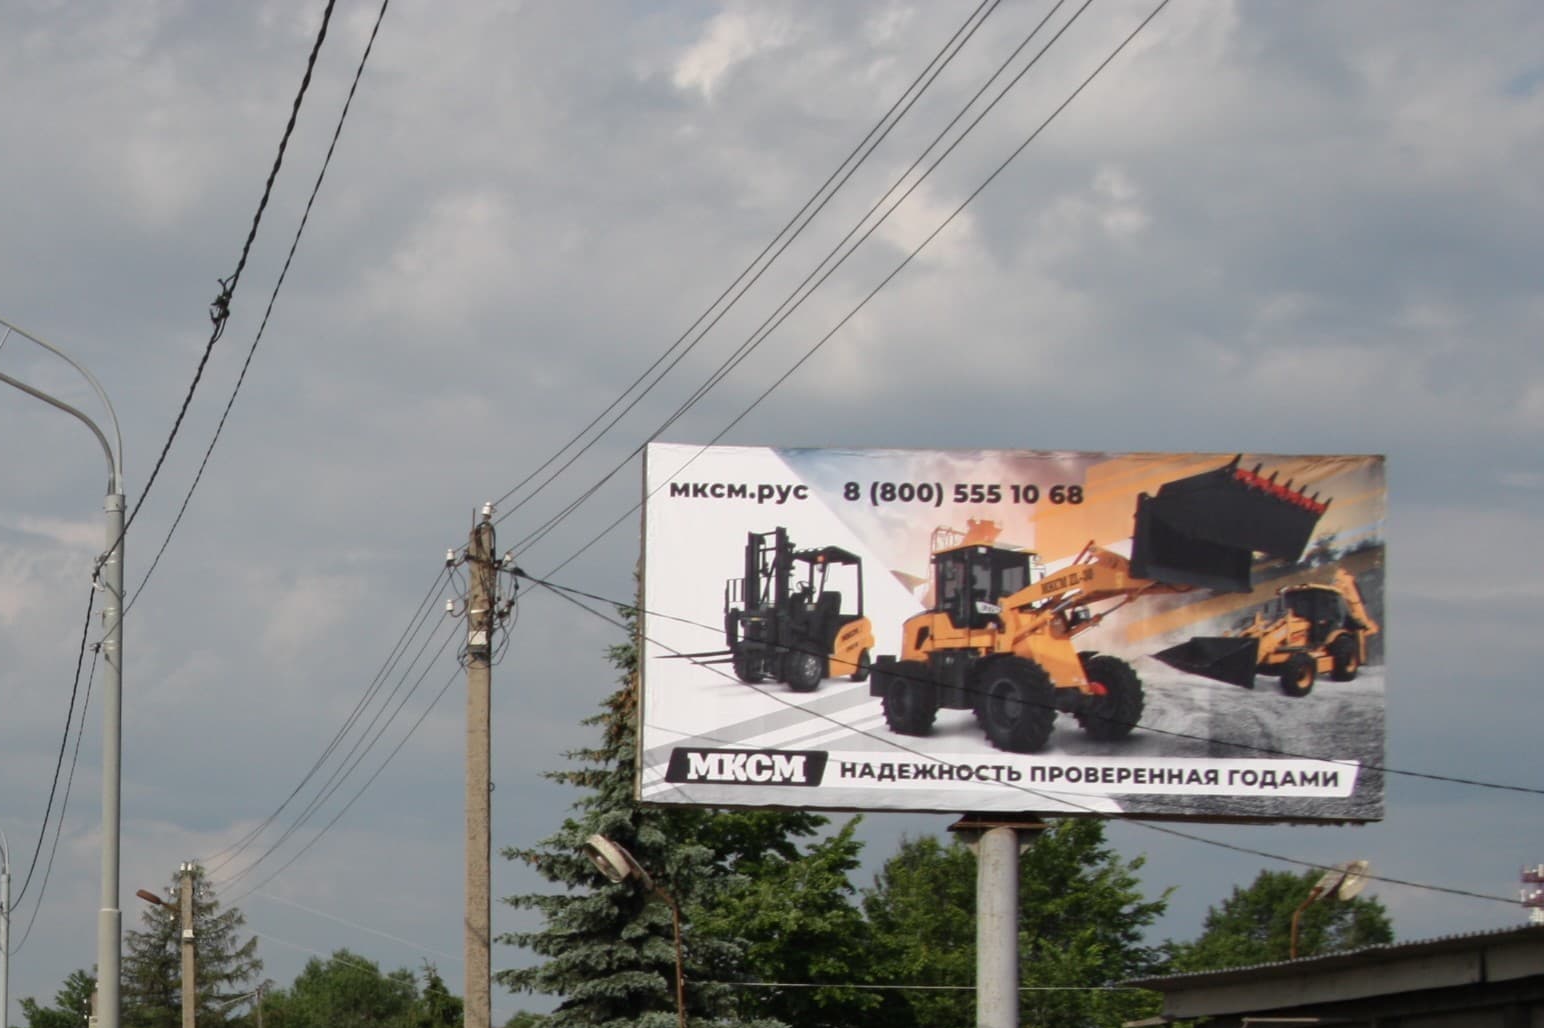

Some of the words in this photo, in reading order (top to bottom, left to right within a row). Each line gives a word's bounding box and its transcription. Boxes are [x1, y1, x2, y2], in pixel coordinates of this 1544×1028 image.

[669, 482, 809, 504] мксм.рус
[843, 481, 861, 501] 8
[870, 481, 943, 507] (800)
[953, 484, 1002, 504] 555
[1010, 484, 1040, 504] 10
[1049, 485, 1084, 505] 68
[685, 752, 807, 784] МКСМ
[839, 762, 1022, 784] НАДЕЖНОСТЬ
[1030, 765, 1220, 786] ПРОВЕРЕННАЯ
[1227, 768, 1340, 789] ГОДАМИ
